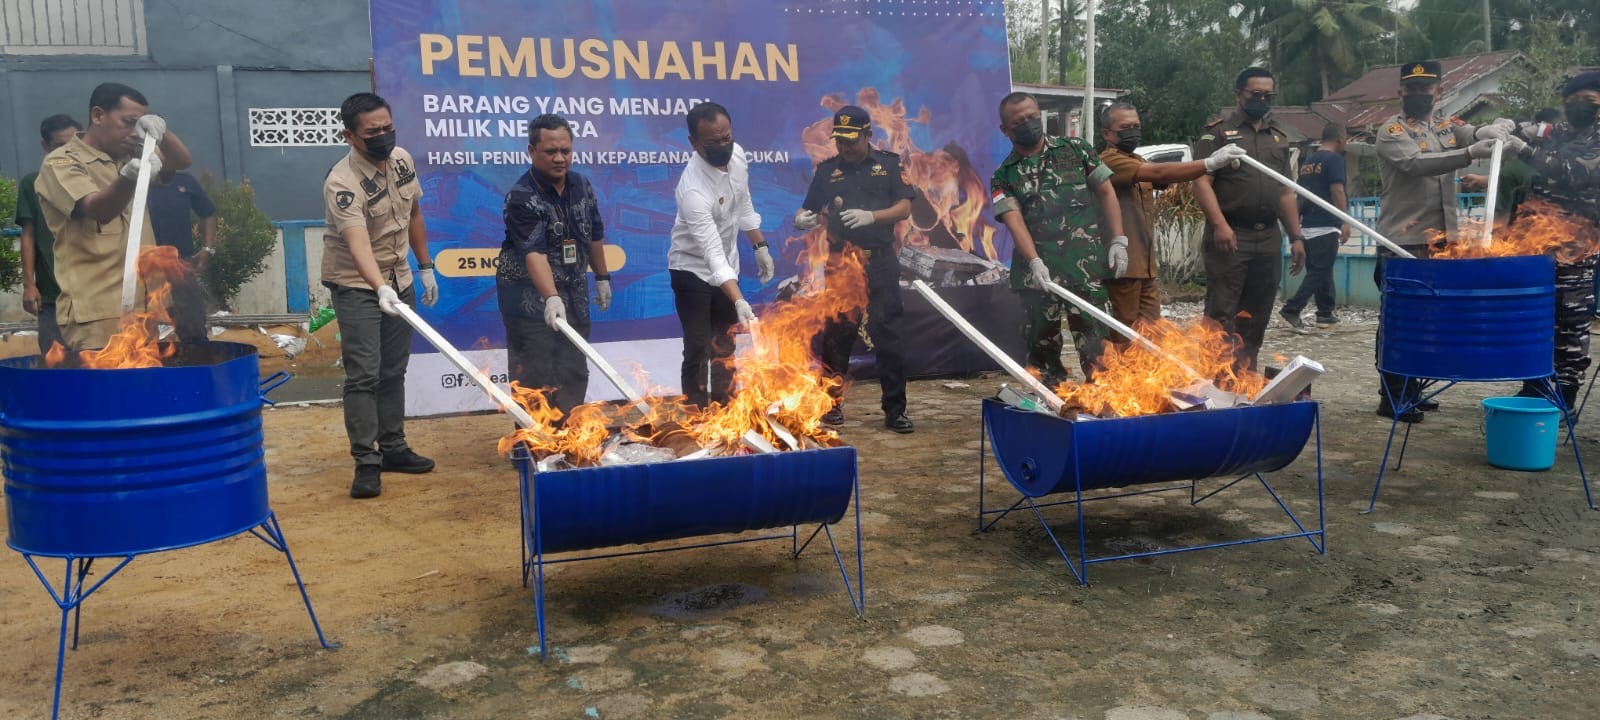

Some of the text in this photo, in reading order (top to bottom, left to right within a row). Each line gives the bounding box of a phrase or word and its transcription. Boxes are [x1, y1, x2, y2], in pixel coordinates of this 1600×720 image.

[419, 33, 800, 82] PEMUSNAHAN
[423, 94, 711, 115] BARANG YANG MENJA
[424, 118, 599, 138] MILIK NERA
[428, 151, 479, 165] HASIL
[482, 151, 594, 165] PENINAN
[743, 151, 789, 163] CUKAI
[457, 257, 477, 269] 25
